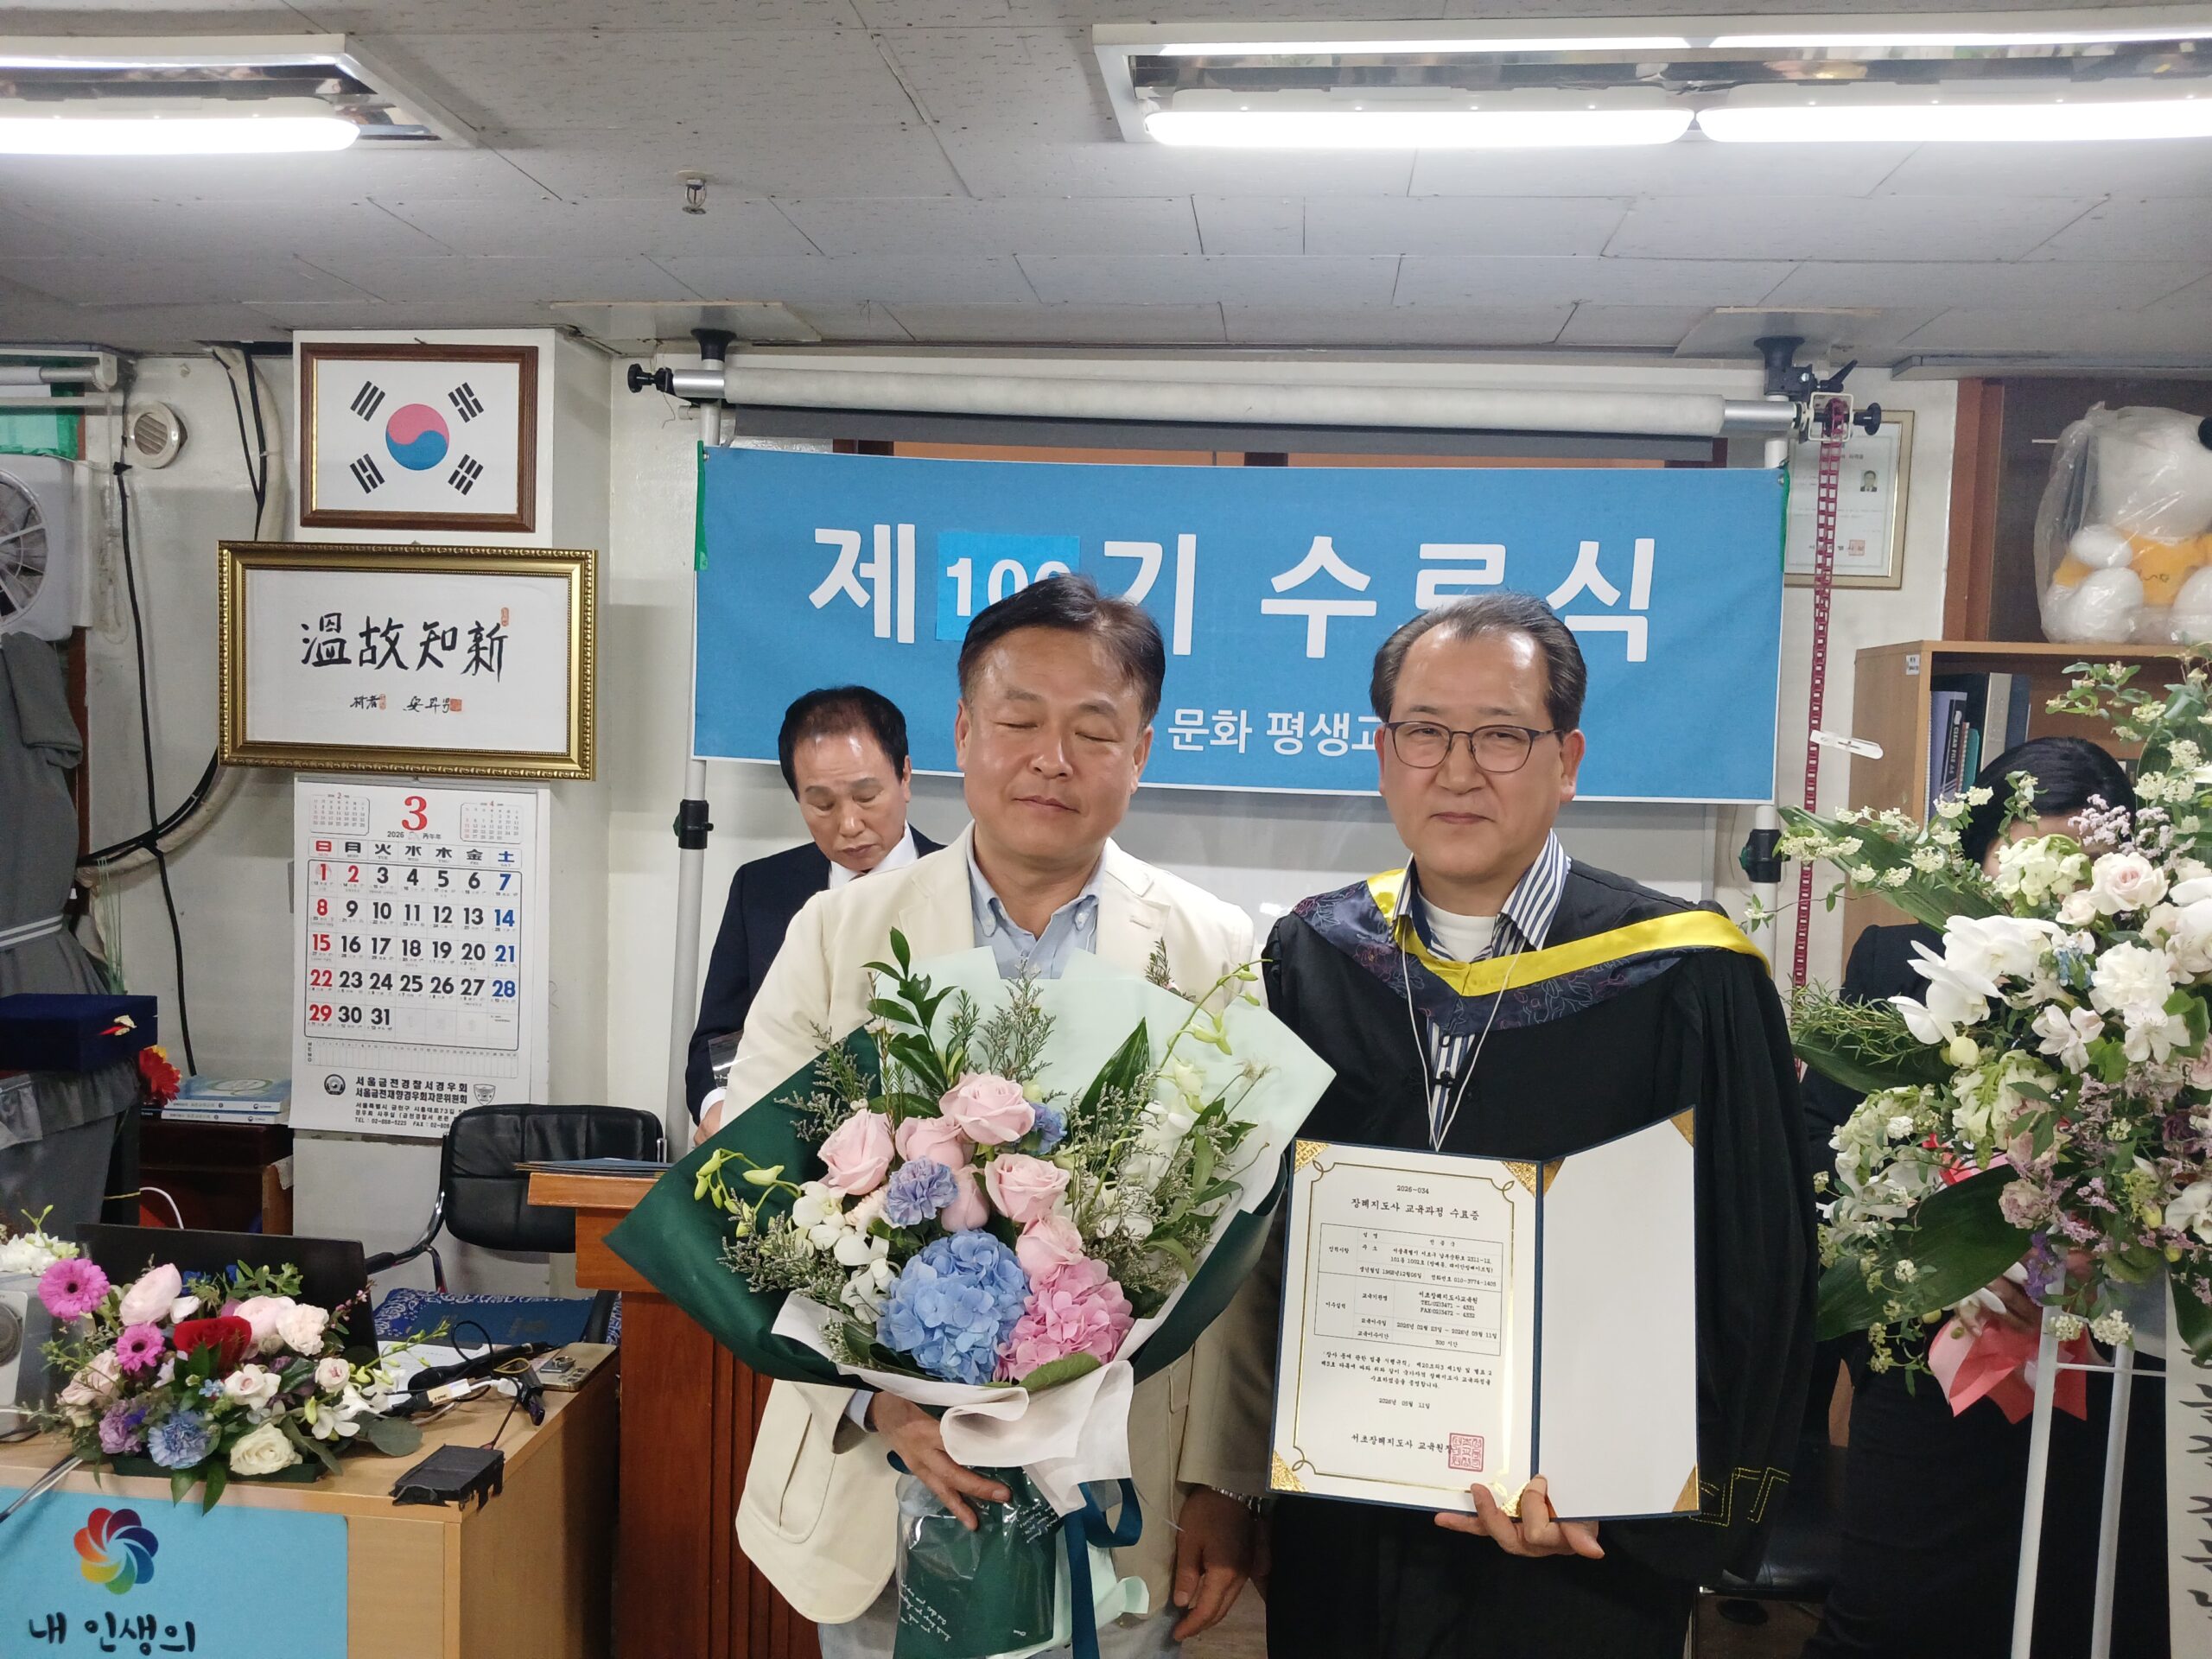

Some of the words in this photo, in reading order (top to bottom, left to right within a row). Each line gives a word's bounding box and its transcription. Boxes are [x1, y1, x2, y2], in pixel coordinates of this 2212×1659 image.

[1168, 708, 1253, 753] 문화
[1951, 727, 1960, 749] CLEAR
[402, 795, 428, 830] 3
[316, 840, 332, 852] 日
[345, 842, 361, 854] 月
[375, 843, 391, 855] 火
[404, 845, 422, 857] 水
[435, 847, 452, 859] 木
[467, 849, 483, 861] 金
[498, 850, 515, 862] 土
[321, 863, 327, 881] 1
[347, 865, 359, 883] 2
[377, 867, 389, 883] 3
[406, 868, 419, 886] 4
[437, 870, 449, 887] 5
[468, 872, 480, 888] 6
[499, 874, 512, 890] 7
[316, 899, 328, 916] 8
[346, 900, 359, 918] 9
[373, 902, 392, 919] 10
[404, 904, 420, 921] 11
[434, 906, 453, 923] 12
[463, 907, 484, 925] 13
[494, 909, 515, 926] 14
[313, 933, 331, 950] 15
[341, 936, 361, 952] 16
[372, 938, 391, 954] 17
[402, 939, 422, 957] 18
[432, 941, 452, 958] 19
[461, 943, 486, 961] 20
[494, 944, 515, 963] 21
[310, 969, 333, 987] 22
[339, 971, 363, 988] 23
[368, 973, 393, 990] 24
[399, 975, 423, 992] 25
[429, 976, 454, 994] 26
[460, 978, 486, 995] 27
[492, 980, 516, 997] 28
[309, 1004, 333, 1021] 29
[338, 1006, 362, 1023] 30
[371, 1007, 391, 1025] 31
[356, 1077, 468, 1092] 서울금천경찰서경우회
[1351, 1198, 1400, 1211] 장례지도사
[1405, 1205, 1444, 1217] 교육과정
[1450, 1210, 1479, 1221] 수료증
[1351, 1433, 1414, 1448] 서초장례지도사
[29, 1611, 67, 1644] 내
[84, 1611, 196, 1656] 인생의
